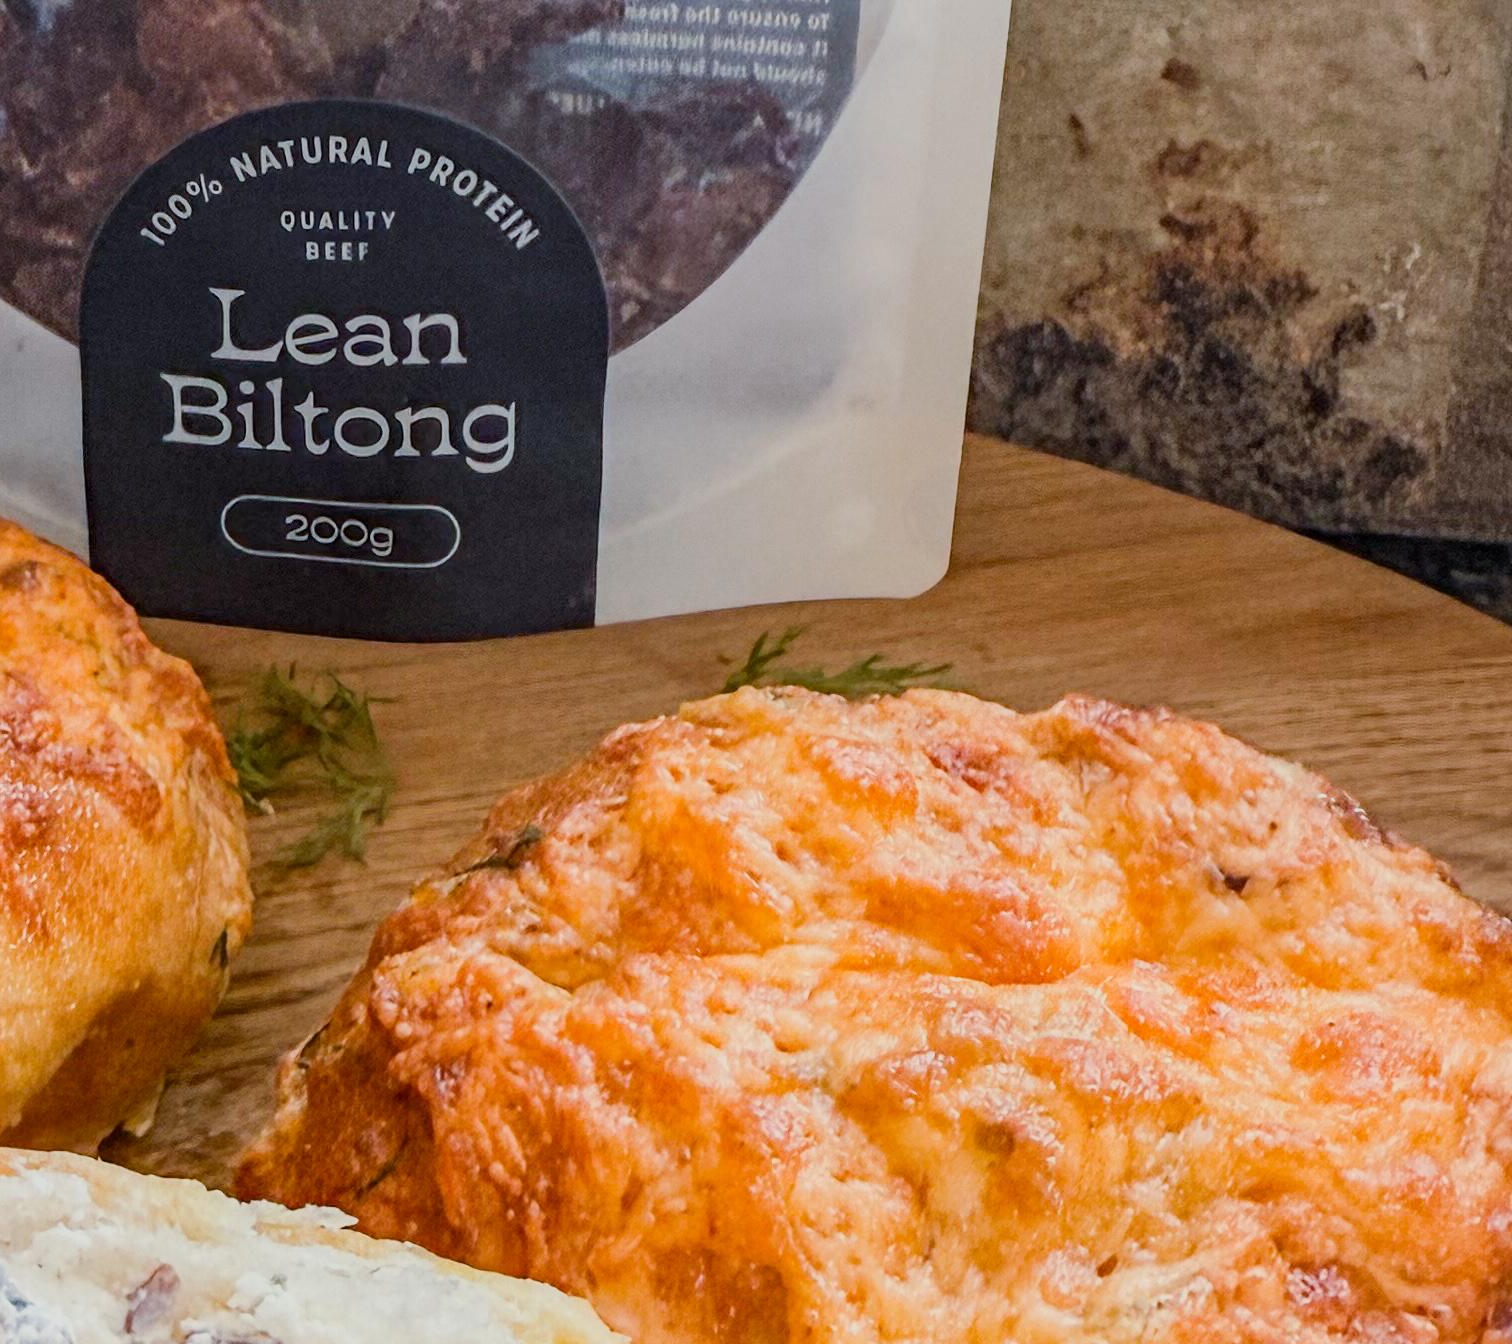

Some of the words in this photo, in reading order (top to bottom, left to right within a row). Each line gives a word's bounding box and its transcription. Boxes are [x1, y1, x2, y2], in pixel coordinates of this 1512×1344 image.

[139, 171, 223, 248] 100%
[229, 135, 393, 183] NATURAL
[407, 147, 542, 251] PROTEIN
[279, 209, 397, 233] QUALITY
[304, 240, 370, 262] BEEF
[208, 286, 468, 367] Lean
[159, 371, 518, 474] Biltong
[284, 513, 394, 557] 200g
